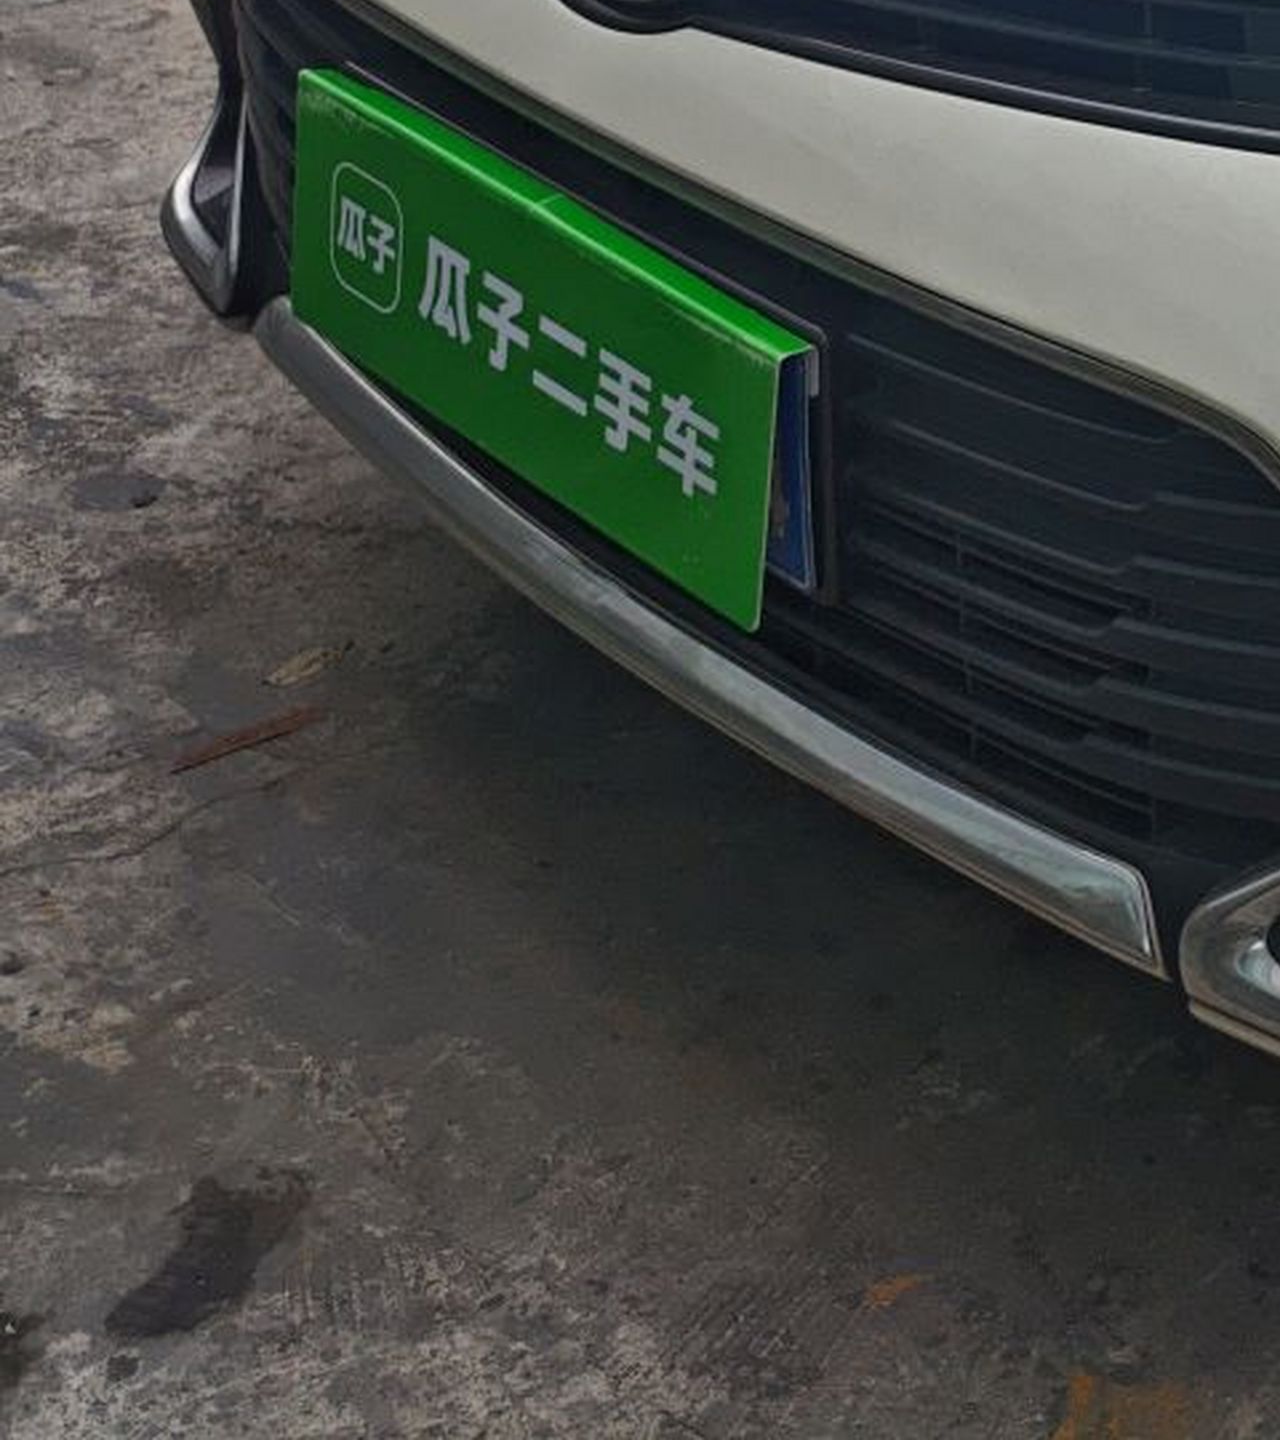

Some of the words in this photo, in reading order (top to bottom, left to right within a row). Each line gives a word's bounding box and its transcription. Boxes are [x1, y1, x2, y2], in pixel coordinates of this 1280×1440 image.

[337, 195, 396, 274] 瓜子
[418, 235, 720, 498] 瓜子二手车
